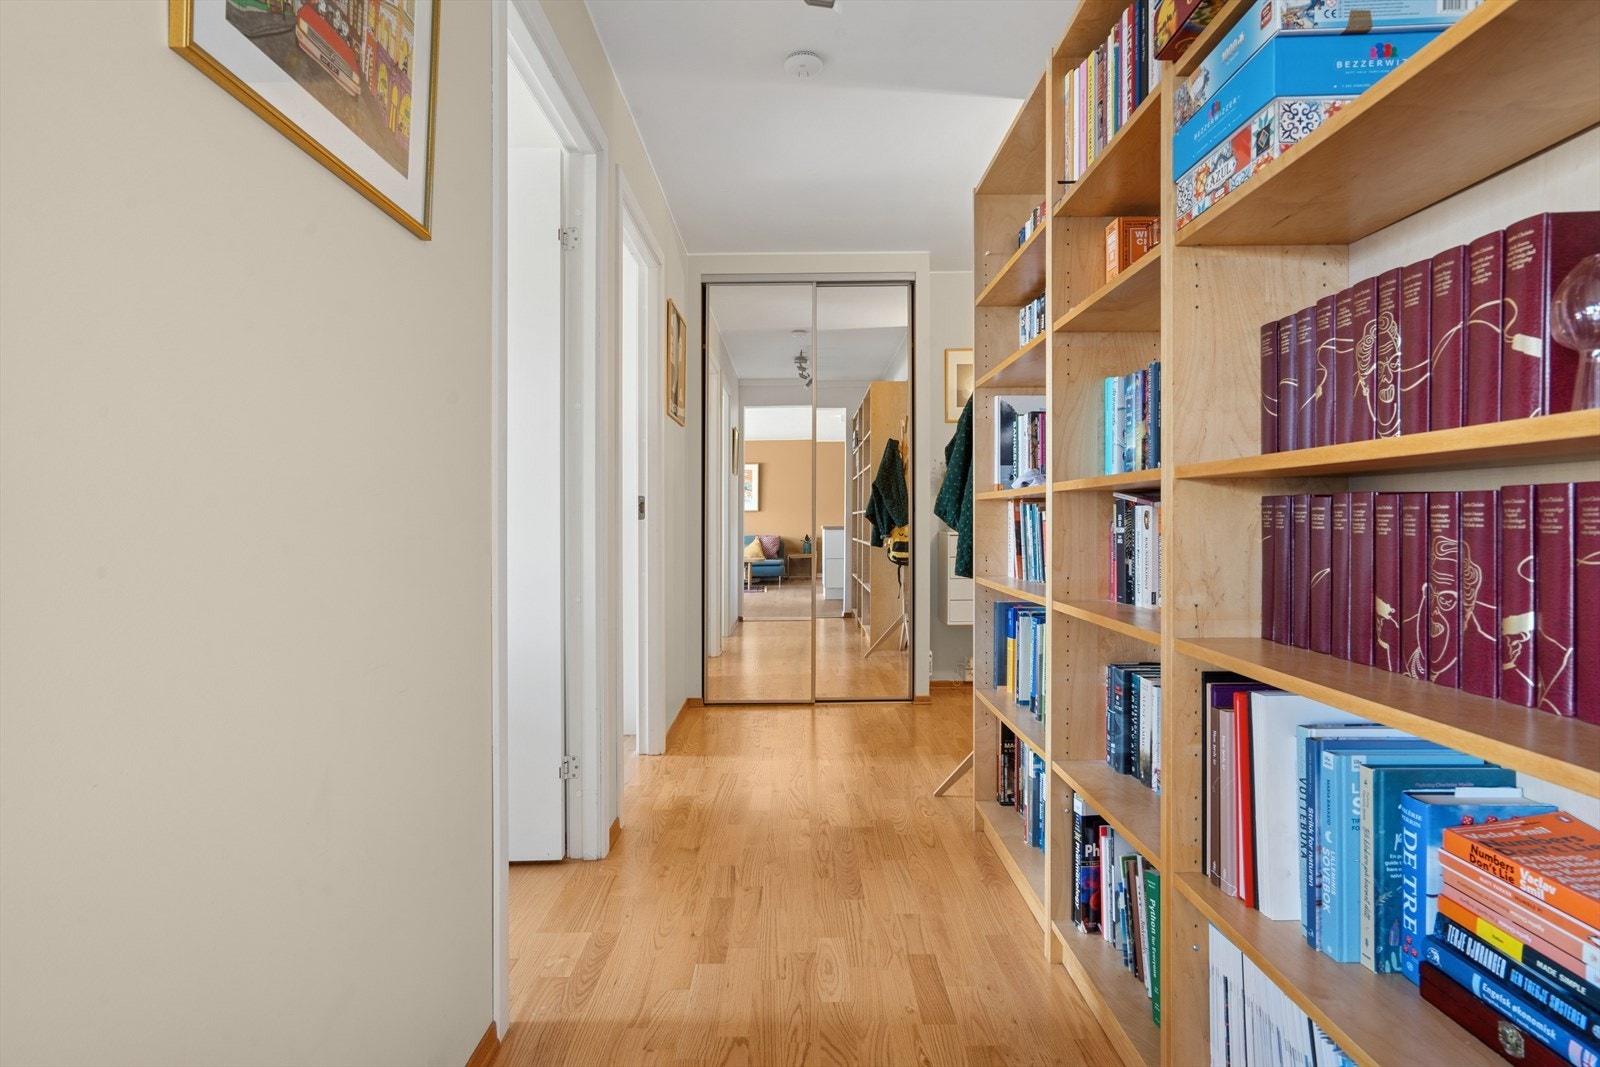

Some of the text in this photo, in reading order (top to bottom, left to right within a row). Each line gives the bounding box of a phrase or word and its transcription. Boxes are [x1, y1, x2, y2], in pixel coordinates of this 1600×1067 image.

[1209, 164, 1233, 189] AZUL
[1084, 844, 1100, 858] Ph
[1470, 843, 1515, 874] Numbers
[1322, 846, 1331, 914] SOVEBOK
[1403, 826, 1418, 935] DE TRE
[1469, 853, 1515, 884] Don't Lie
[1519, 867, 1557, 895] Vaclav
[1519, 880, 1545, 900] Smil
[1149, 898, 1157, 934] Python
[1447, 924, 1467, 952] TERJE
[1536, 960, 1587, 996] MADE SIMPLE
[1482, 983, 1557, 1041] Engelsk økonomisk
